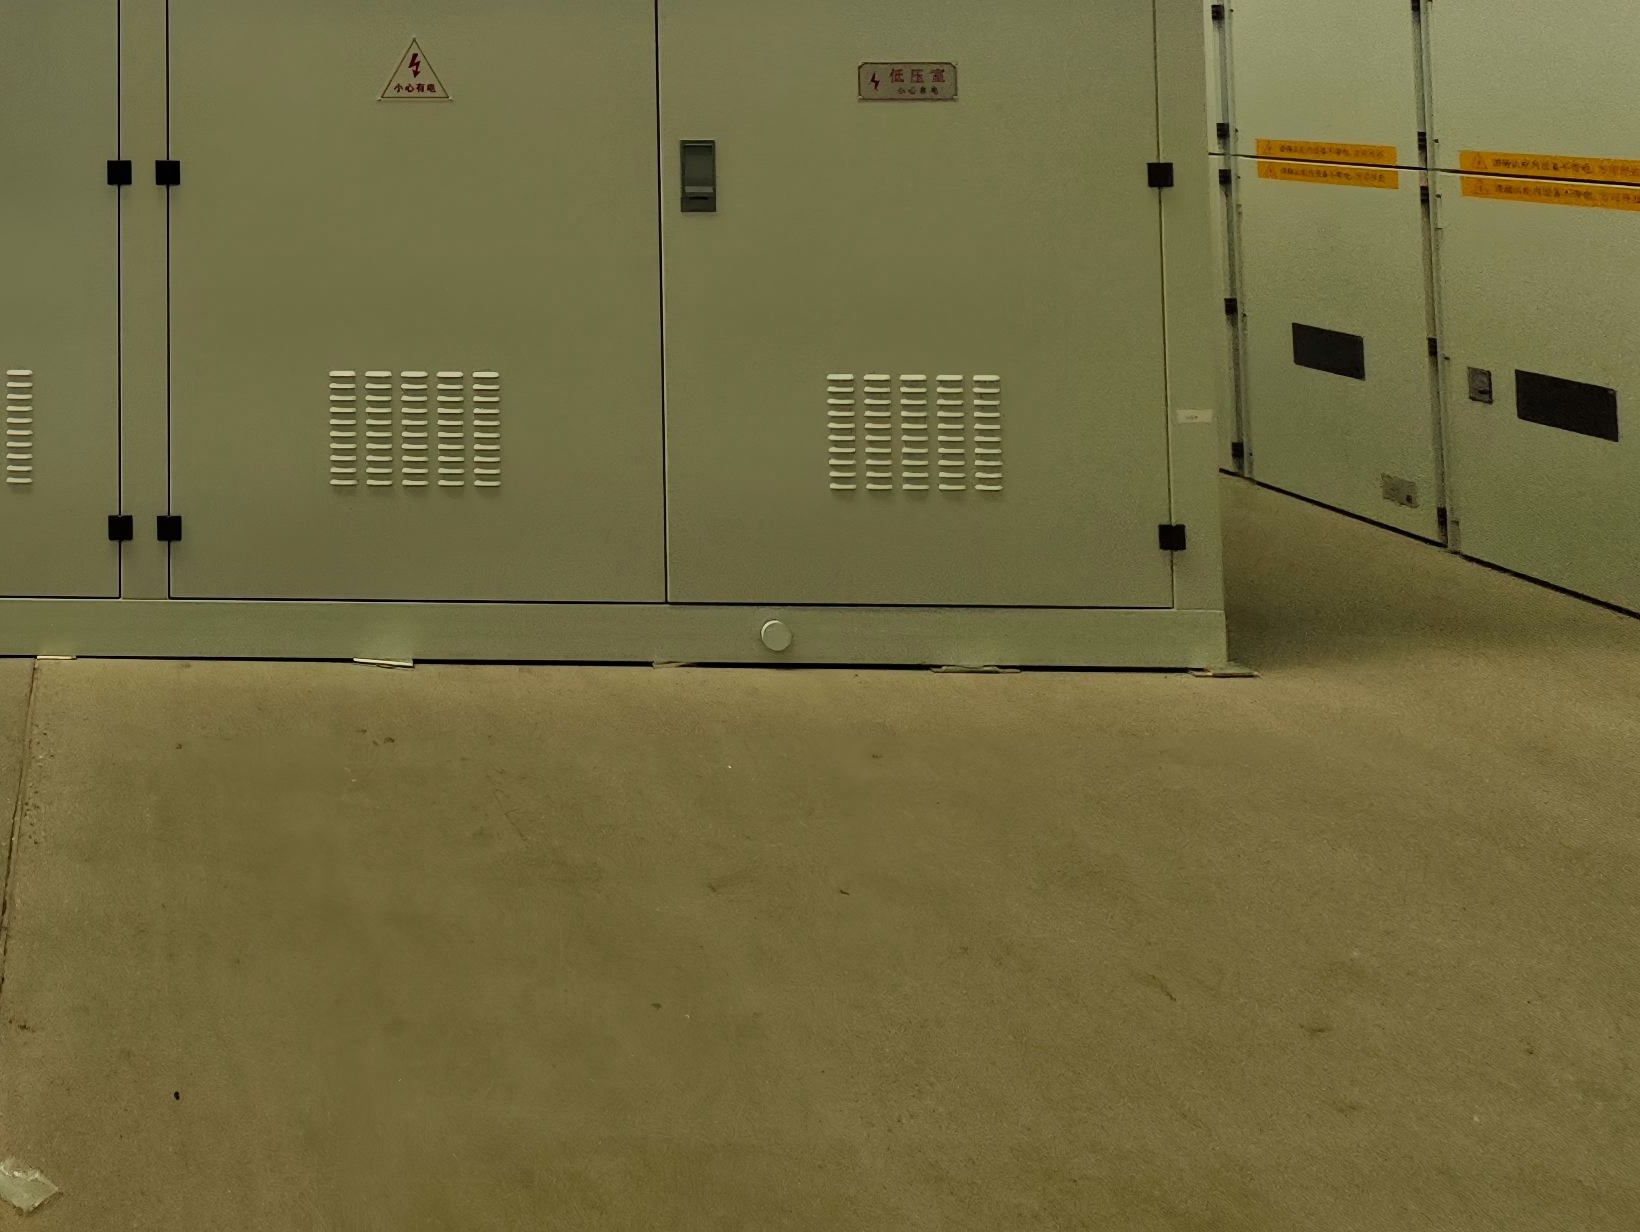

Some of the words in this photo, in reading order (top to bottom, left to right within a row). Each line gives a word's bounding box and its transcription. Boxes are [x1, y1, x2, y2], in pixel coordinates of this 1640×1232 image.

[888, 68, 946, 83] 低压室
[393, 82, 437, 93] 小心有电
